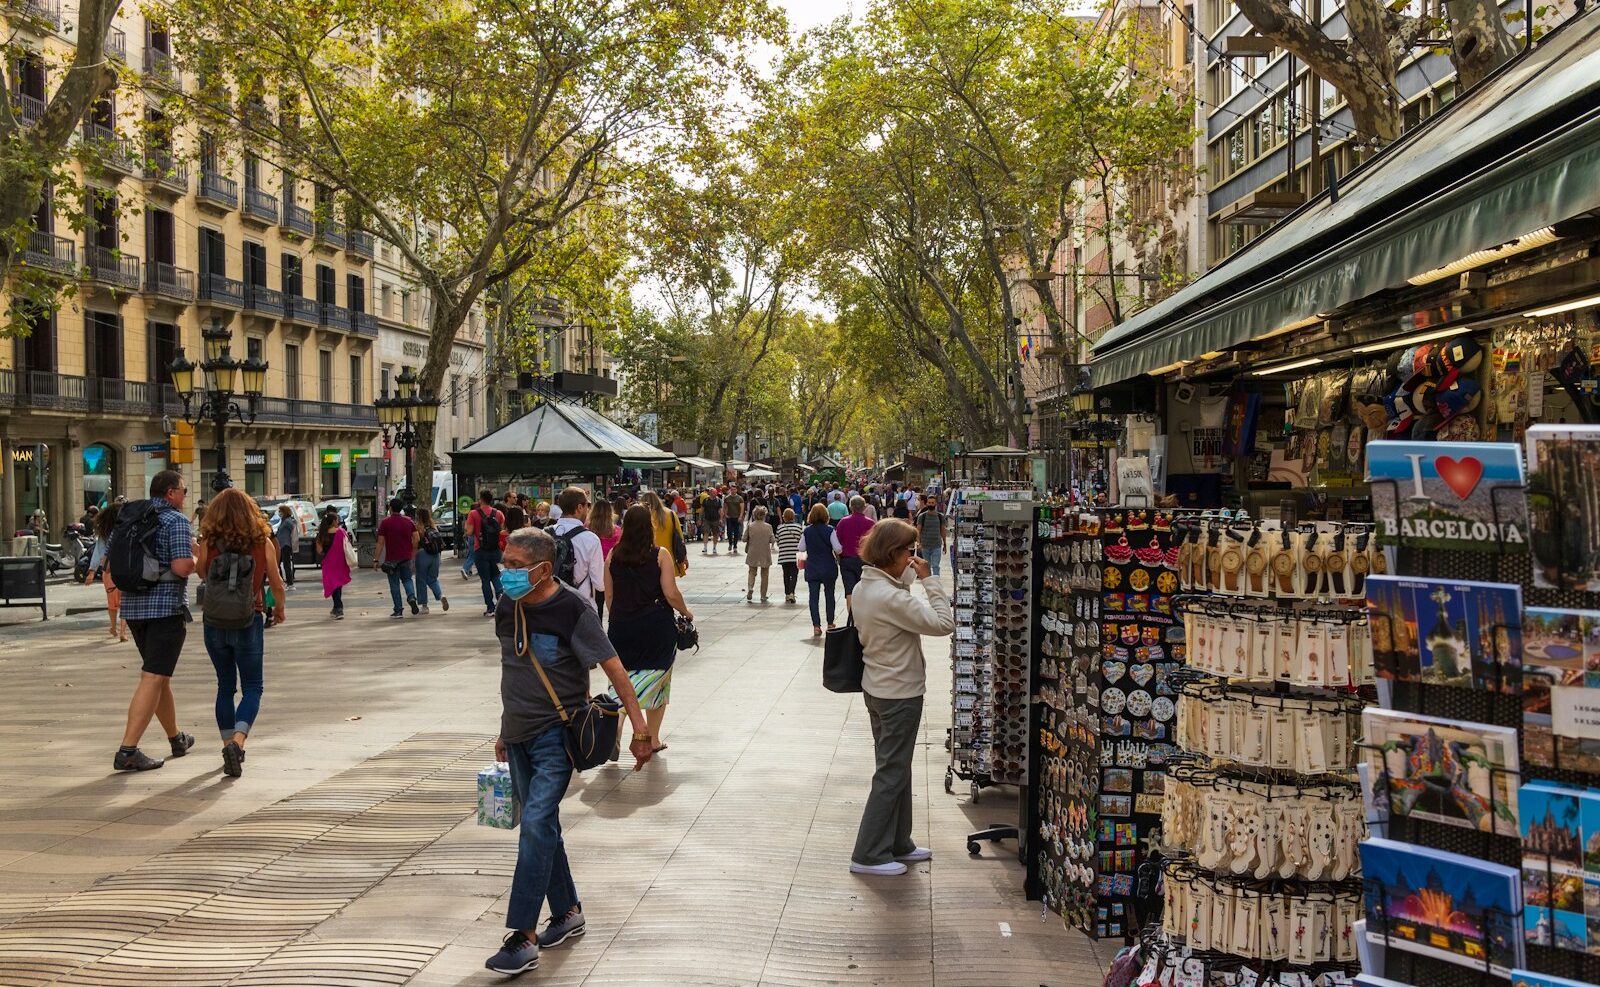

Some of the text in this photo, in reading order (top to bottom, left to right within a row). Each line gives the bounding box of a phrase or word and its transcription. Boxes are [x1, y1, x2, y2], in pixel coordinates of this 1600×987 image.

[1193, 440, 1222, 456] BAND
[1404, 454, 1431, 500] I
[1383, 517, 1524, 544] BARCELONA
